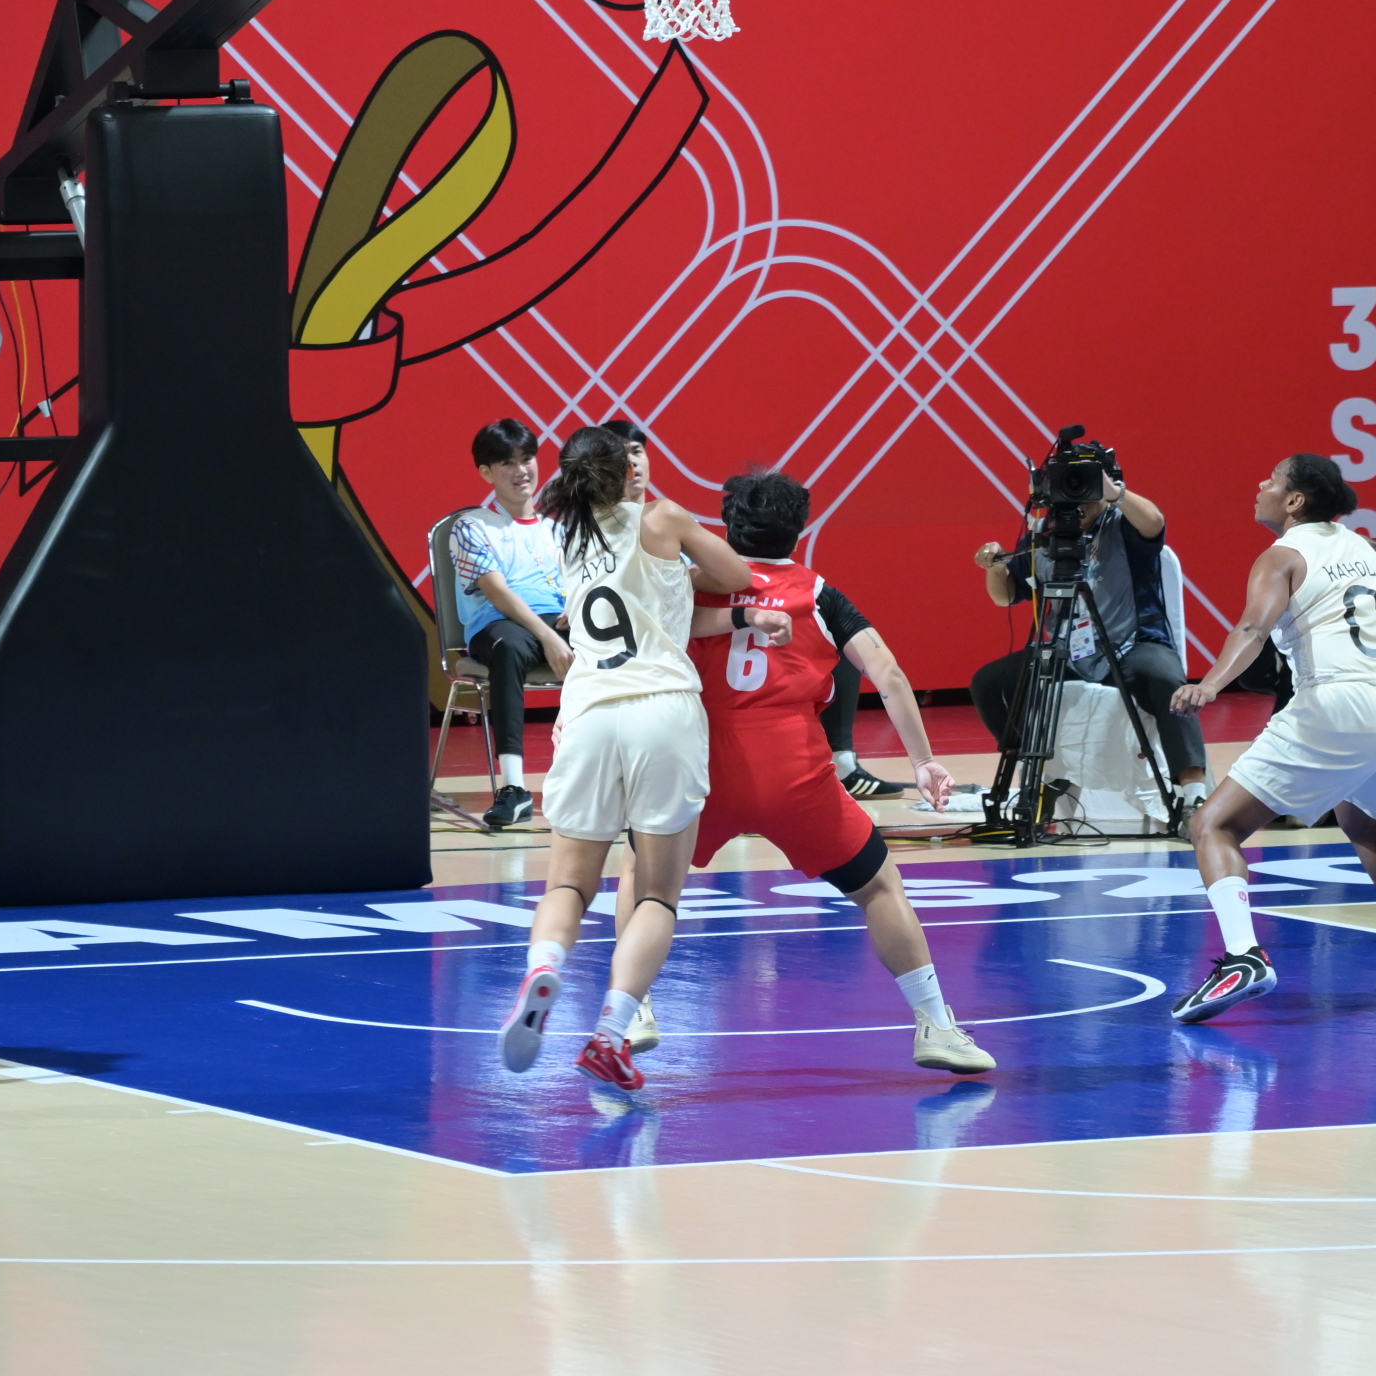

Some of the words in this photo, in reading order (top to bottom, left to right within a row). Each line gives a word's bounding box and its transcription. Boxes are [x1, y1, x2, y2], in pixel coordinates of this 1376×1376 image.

[580, 553, 617, 585] AYU
[729, 592, 756, 607] LIM
[758, 595, 769, 608] J
[771, 597, 785, 609] M
[581, 585, 638, 670] 9
[726, 626, 771, 692] 6
